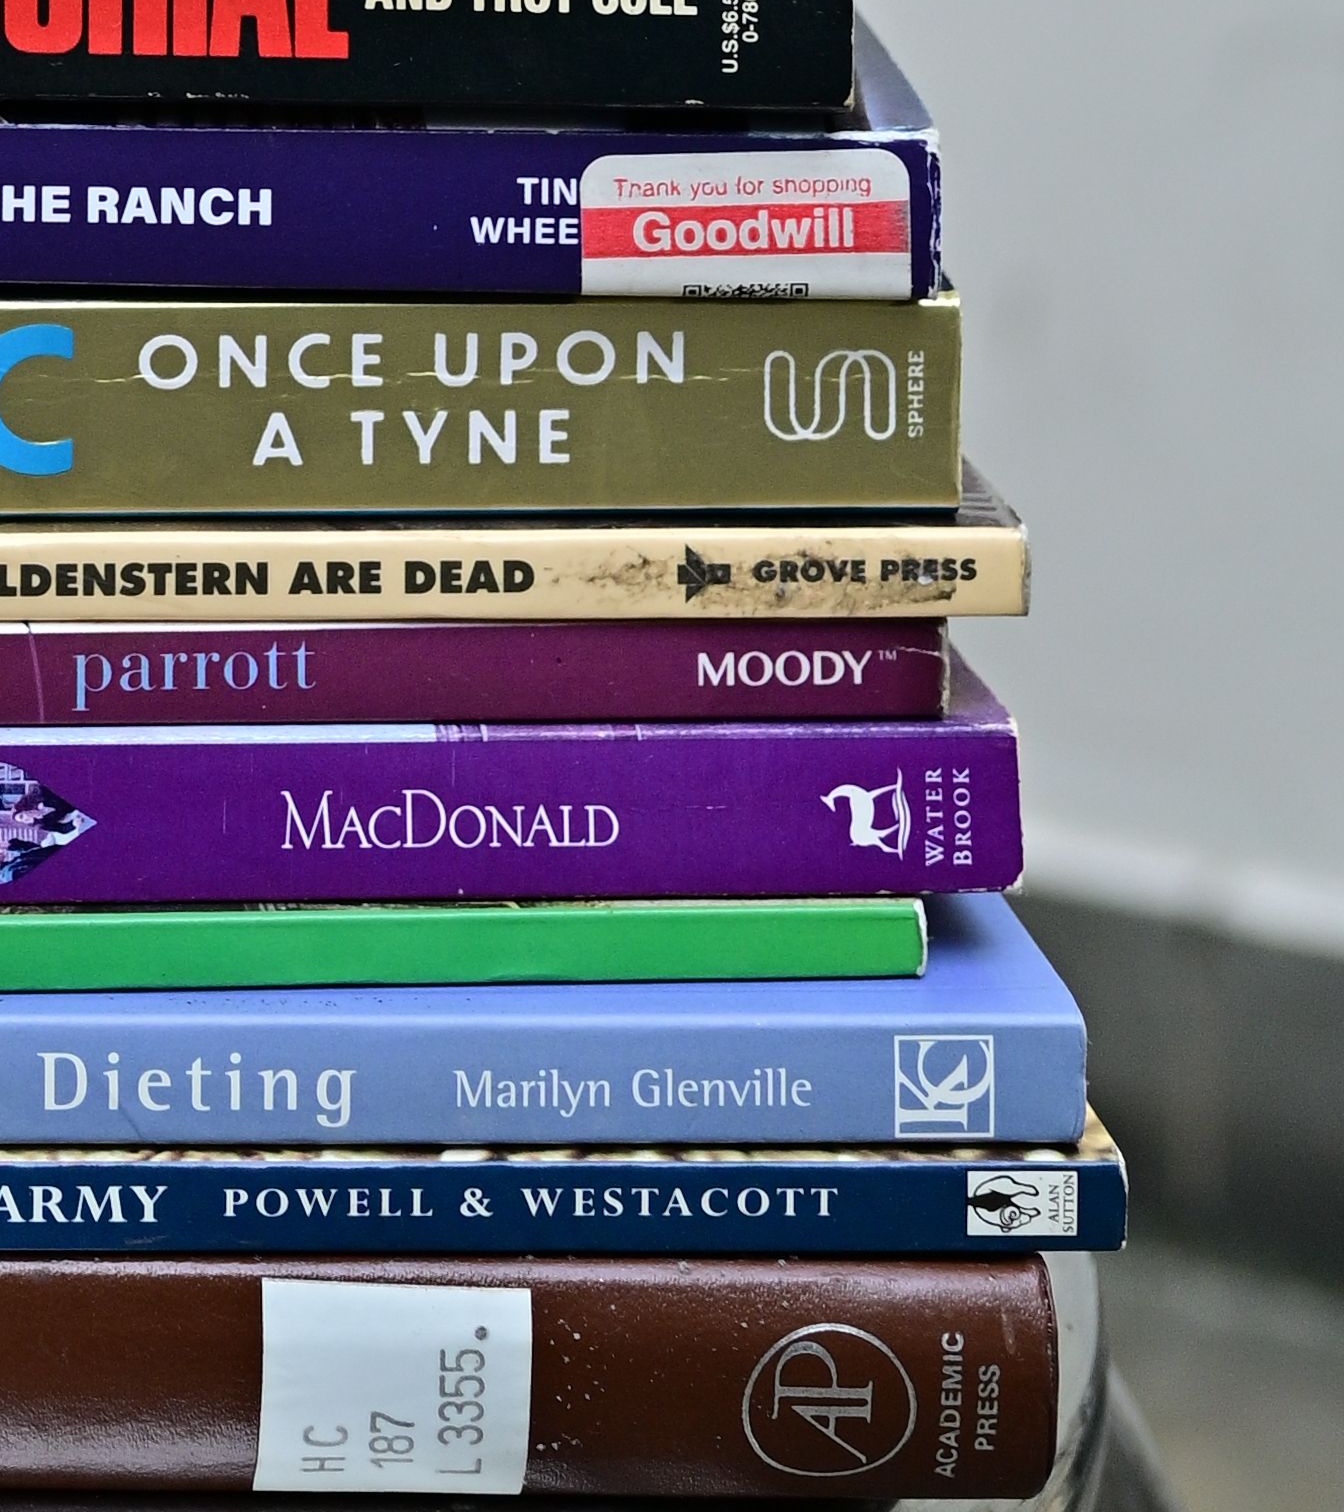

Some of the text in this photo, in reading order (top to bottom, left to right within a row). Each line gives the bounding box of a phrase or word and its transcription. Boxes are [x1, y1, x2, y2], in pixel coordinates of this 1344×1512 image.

[87, 185, 273, 226] RANCH
[515, 176, 579, 206] TIN
[690, 180, 728, 202] you
[735, 175, 765, 197] for
[469, 216, 579, 246] WHEE
[632, 206, 855, 254] Goodwill
[138, 330, 687, 390] ONCE UPON
[906, 349, 925, 439] SPHERE
[251, 409, 572, 466] A TYNE
[288, 560, 383, 596] ARE
[404, 559, 536, 596] DEAD
[752, 557, 978, 586] GROVE PRESS
[71, 639, 318, 713] parrott
[697, 650, 872, 687] MOODY
[924, 767, 944, 867] WATER
[954, 766, 973, 867] BROOK
[37, 1050, 358, 1129] Dieting
[453, 1066, 813, 1118] Marilyn Glenville
[223, 1187, 841, 1218] POWELL & WESTACOTT
[1048, 1184, 1060, 1223] ALAN
[1062, 1174, 1075, 1234] SUTTON
[932, 1331, 965, 1480] ACADEMIC
[974, 1364, 1001, 1452] PRESS
[368, 1410, 416, 1470] 187
